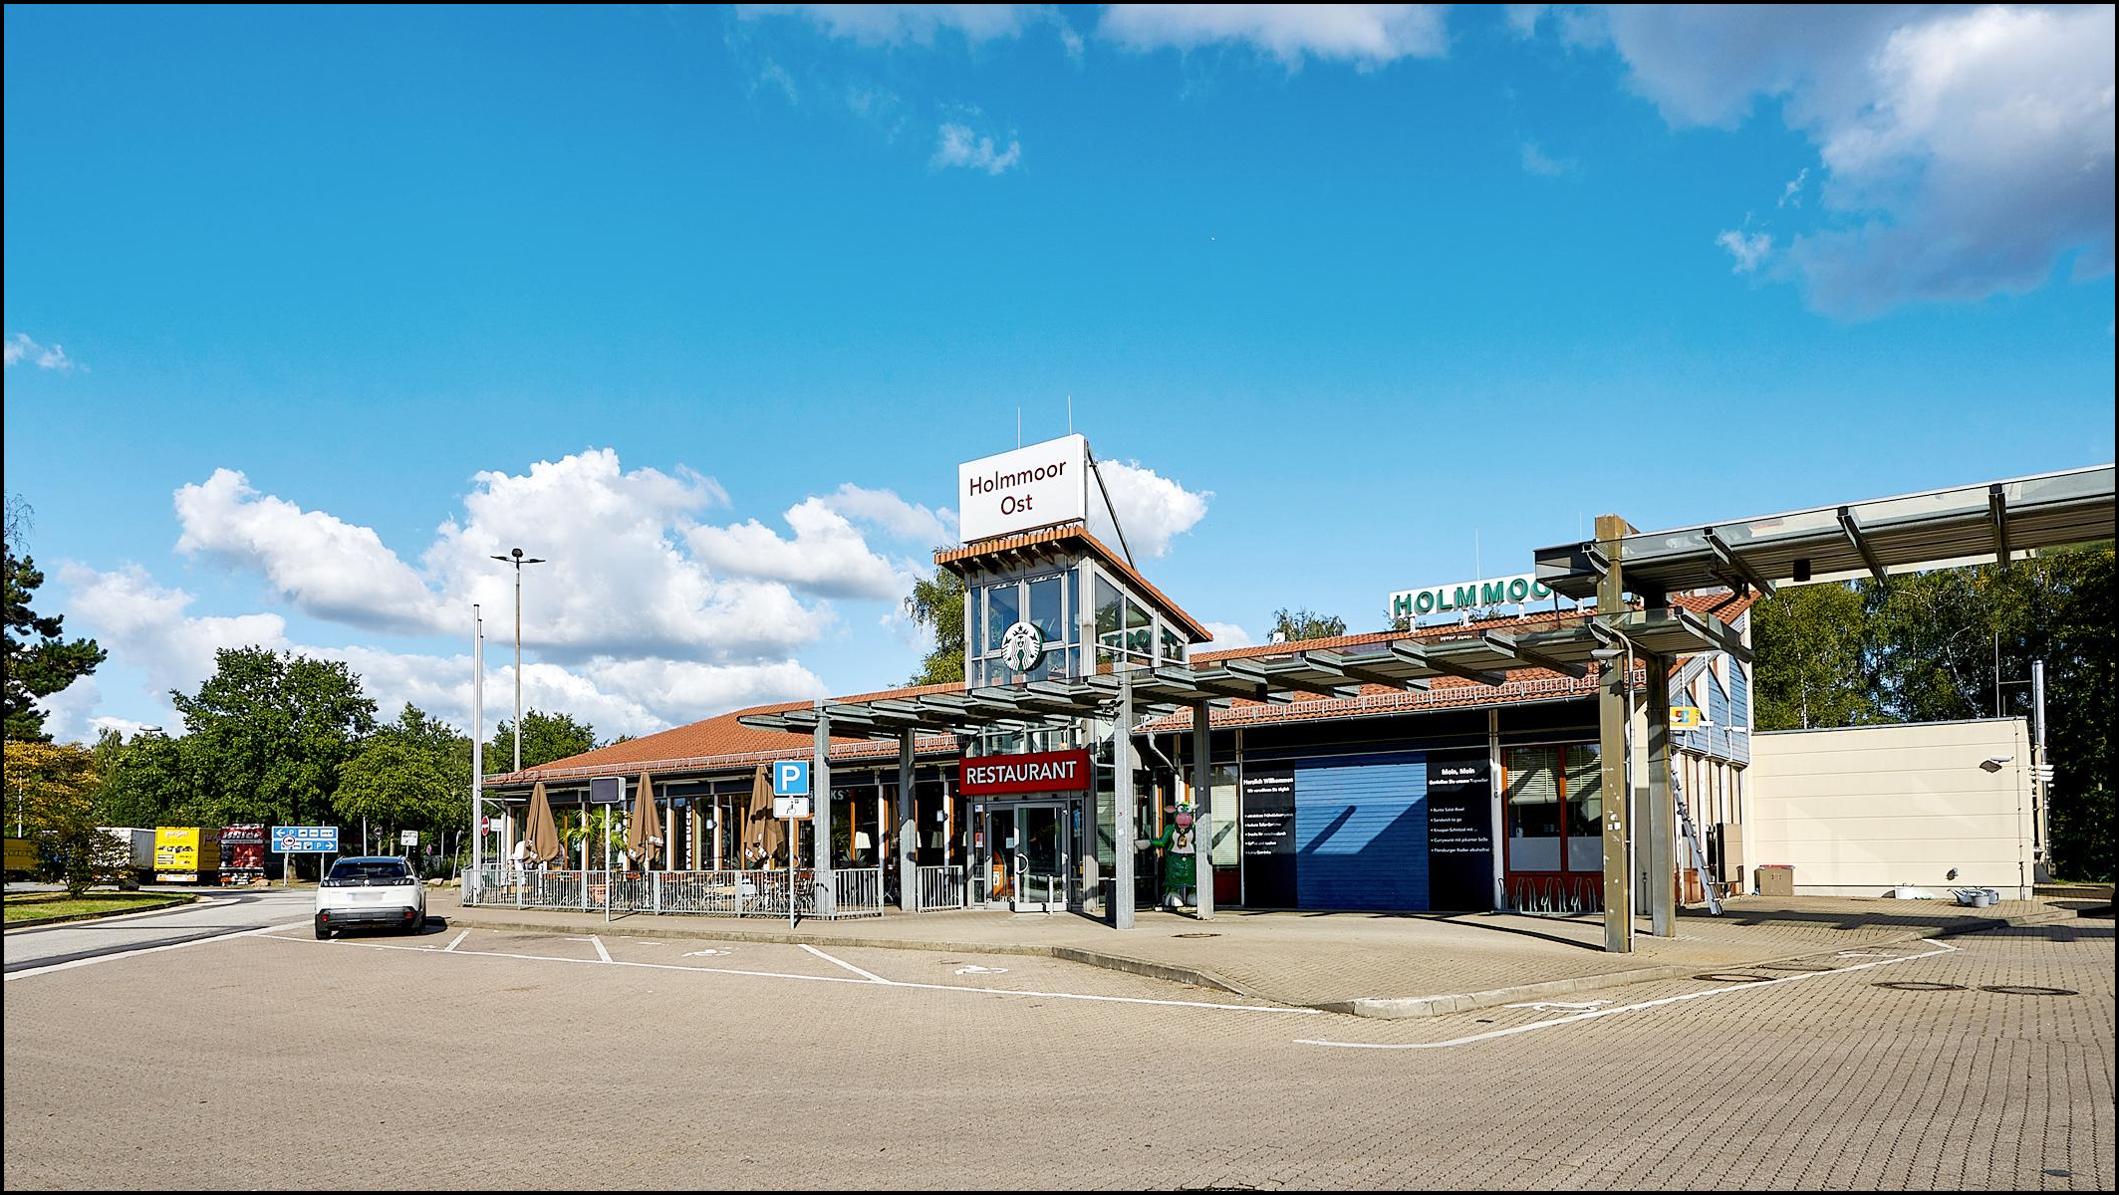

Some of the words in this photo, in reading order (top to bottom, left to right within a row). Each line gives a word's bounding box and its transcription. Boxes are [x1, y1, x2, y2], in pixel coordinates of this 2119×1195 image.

[970, 461, 1066, 496] Holmmoor
[1001, 494, 1033, 515] Ost
[1394, 578, 1552, 617] HOLMMOO
[782, 766, 801, 791] P
[966, 760, 1077, 784] RESTAURANT
